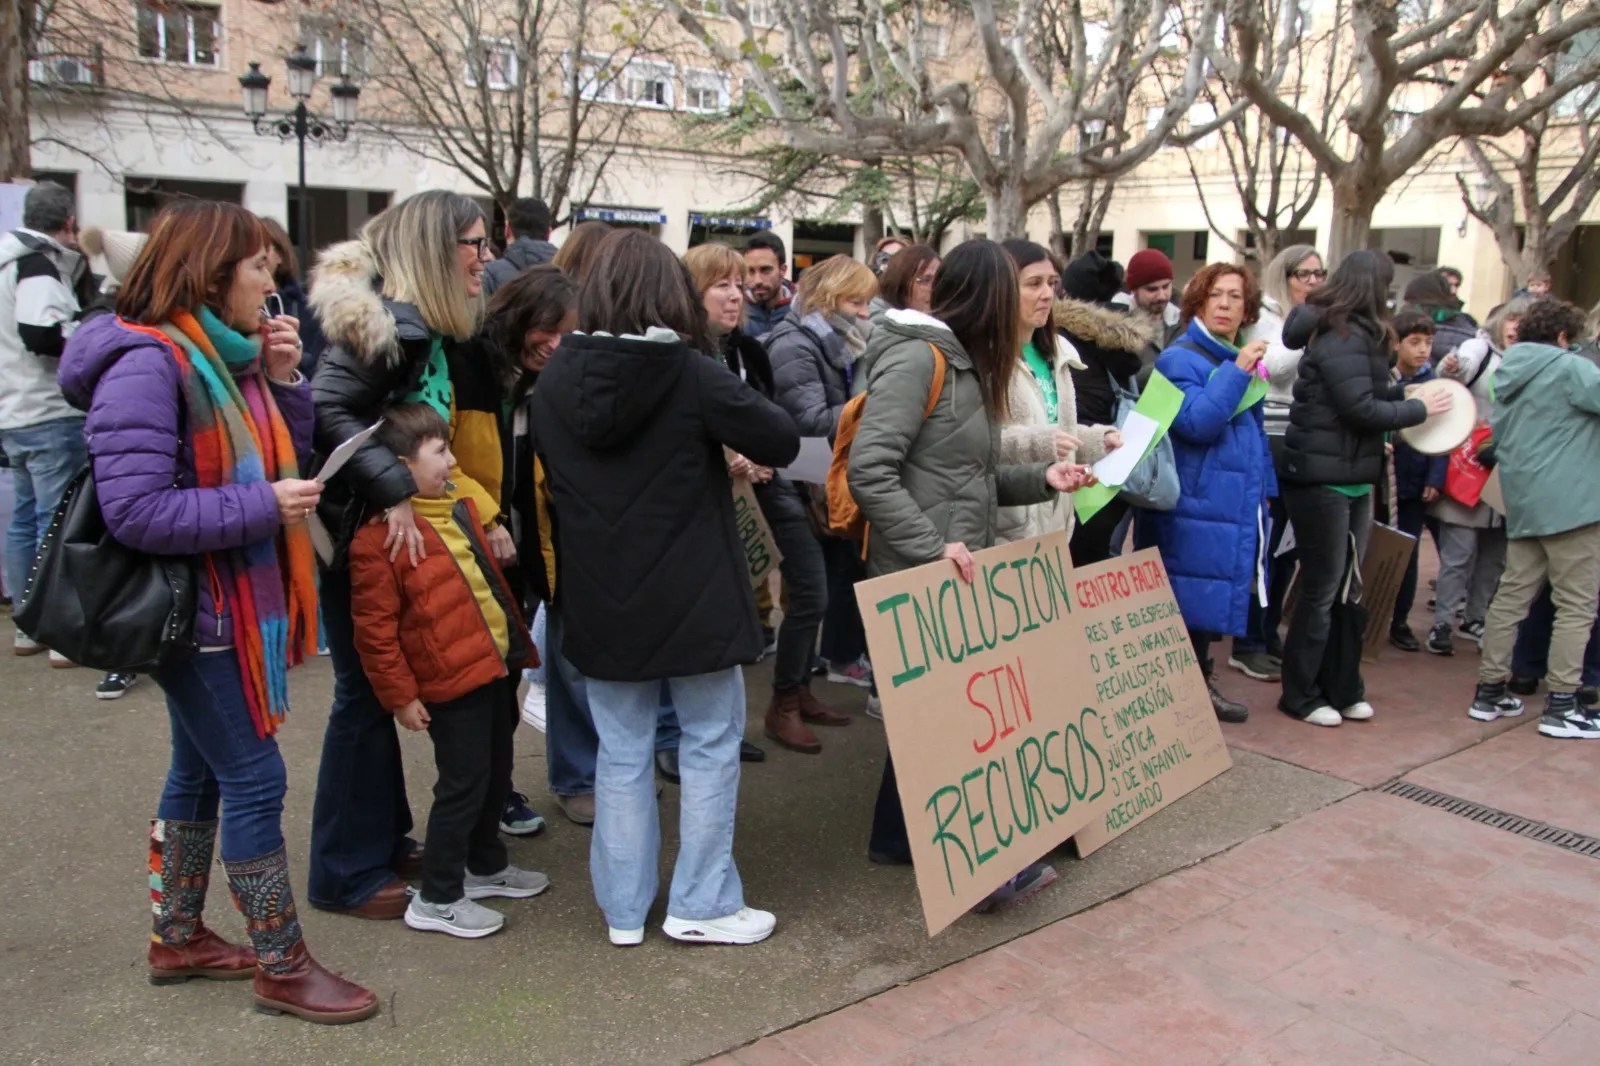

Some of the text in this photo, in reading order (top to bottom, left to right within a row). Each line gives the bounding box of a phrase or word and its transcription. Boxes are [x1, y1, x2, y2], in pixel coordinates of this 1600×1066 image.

[1076, 571, 1131, 608] CENTRO
[876, 541, 1072, 688] INCLUSIÓN
[1085, 621, 1108, 645] RES
[1111, 615, 1124, 635] DE
[1090, 653, 1100, 673] O
[1105, 646, 1120, 669] DE
[966, 656, 1032, 753] SIN
[1101, 715, 1113, 739] E
[1122, 766, 1141, 791] DE
[925, 707, 1106, 896] RECURSOS
[1105, 781, 1163, 833] ADECUADO
